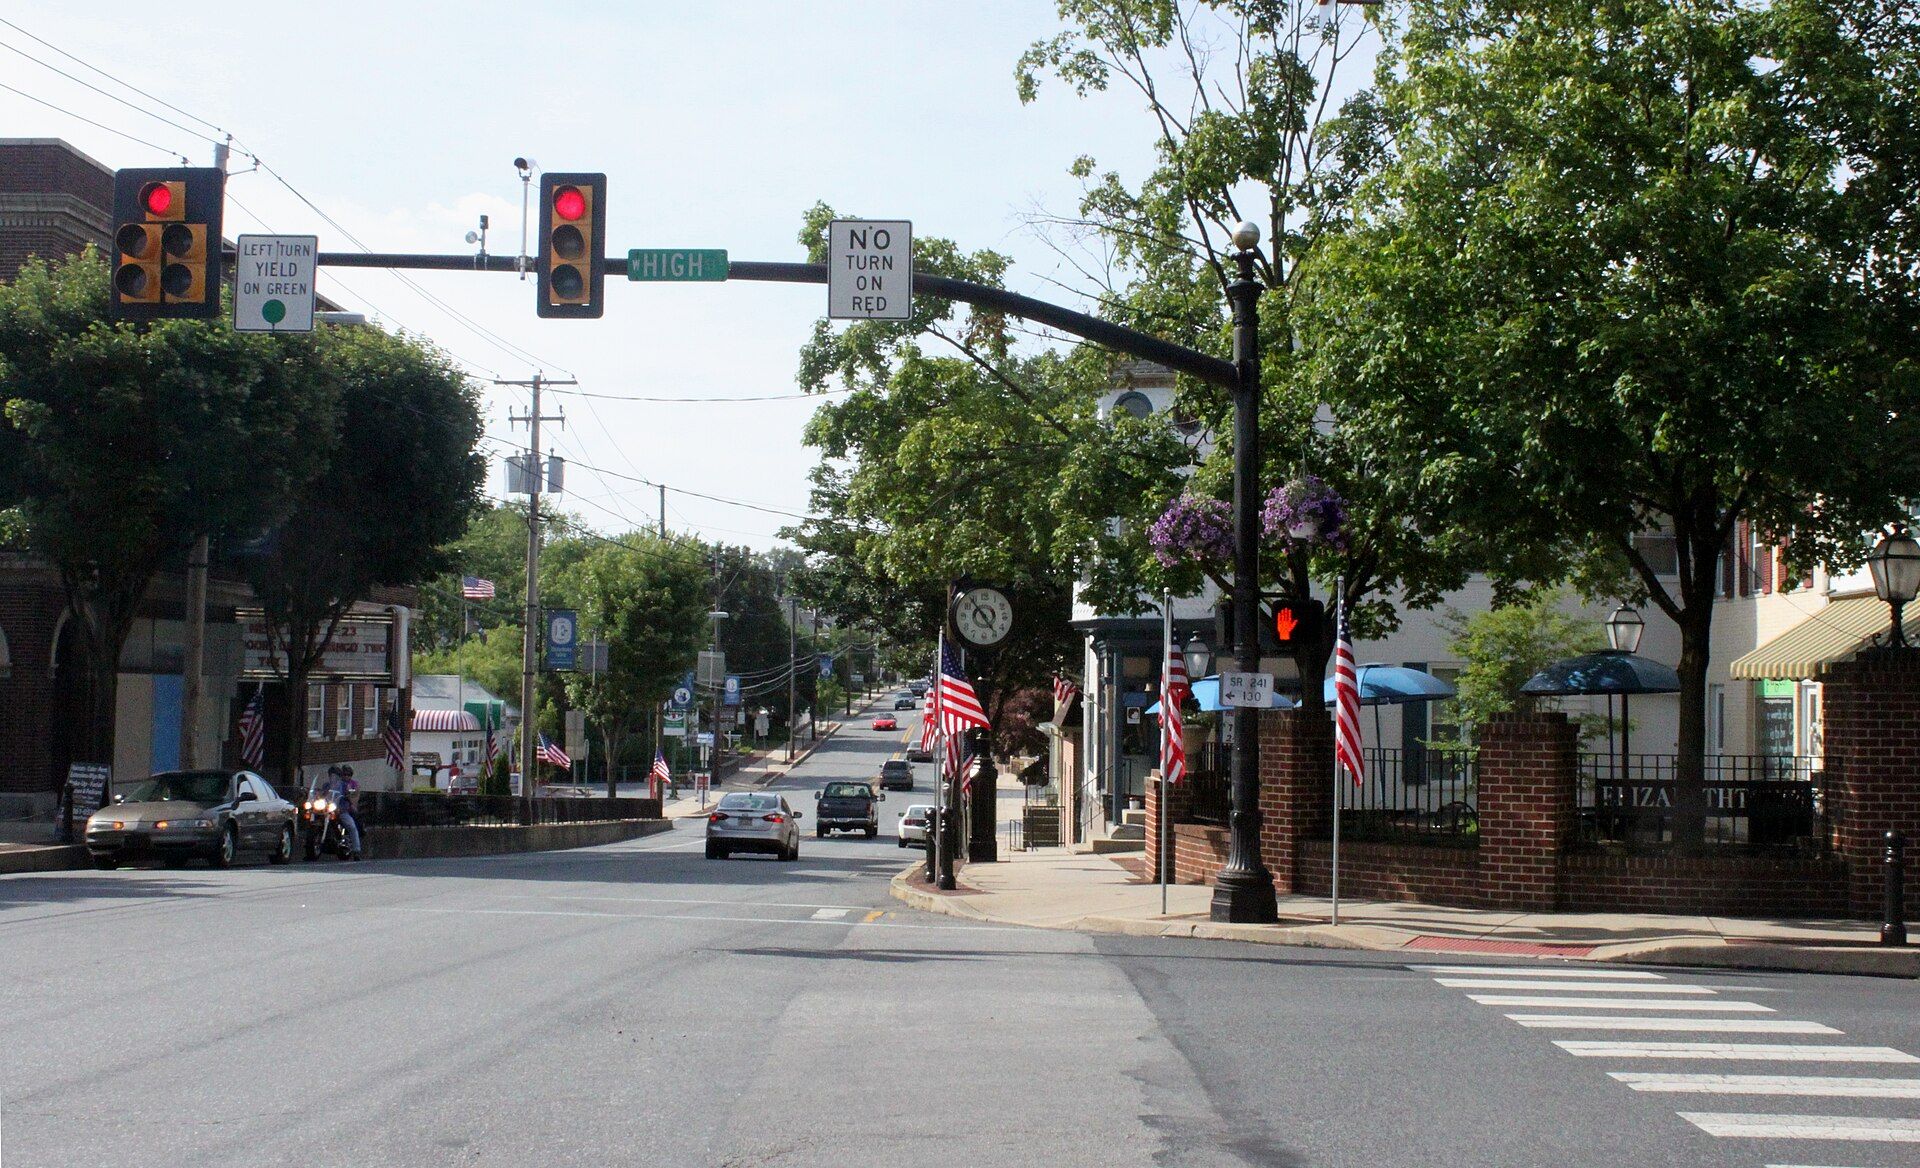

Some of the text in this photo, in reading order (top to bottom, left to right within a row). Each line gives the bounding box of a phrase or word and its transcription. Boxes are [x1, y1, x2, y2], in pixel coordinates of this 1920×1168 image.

[849, 229, 890, 250] NO
[244, 244, 310, 256] LEFT TURN
[256, 262, 297, 277] YIELD
[643, 252, 703, 277] HIGH
[846, 255, 892, 270] TURN
[243, 282, 307, 295] ON GREEN
[856, 275, 882, 291] ON
[852, 296, 887, 311] RED
[1230, 676, 1267, 688] SR 241
[1243, 691, 1262, 702] 130
